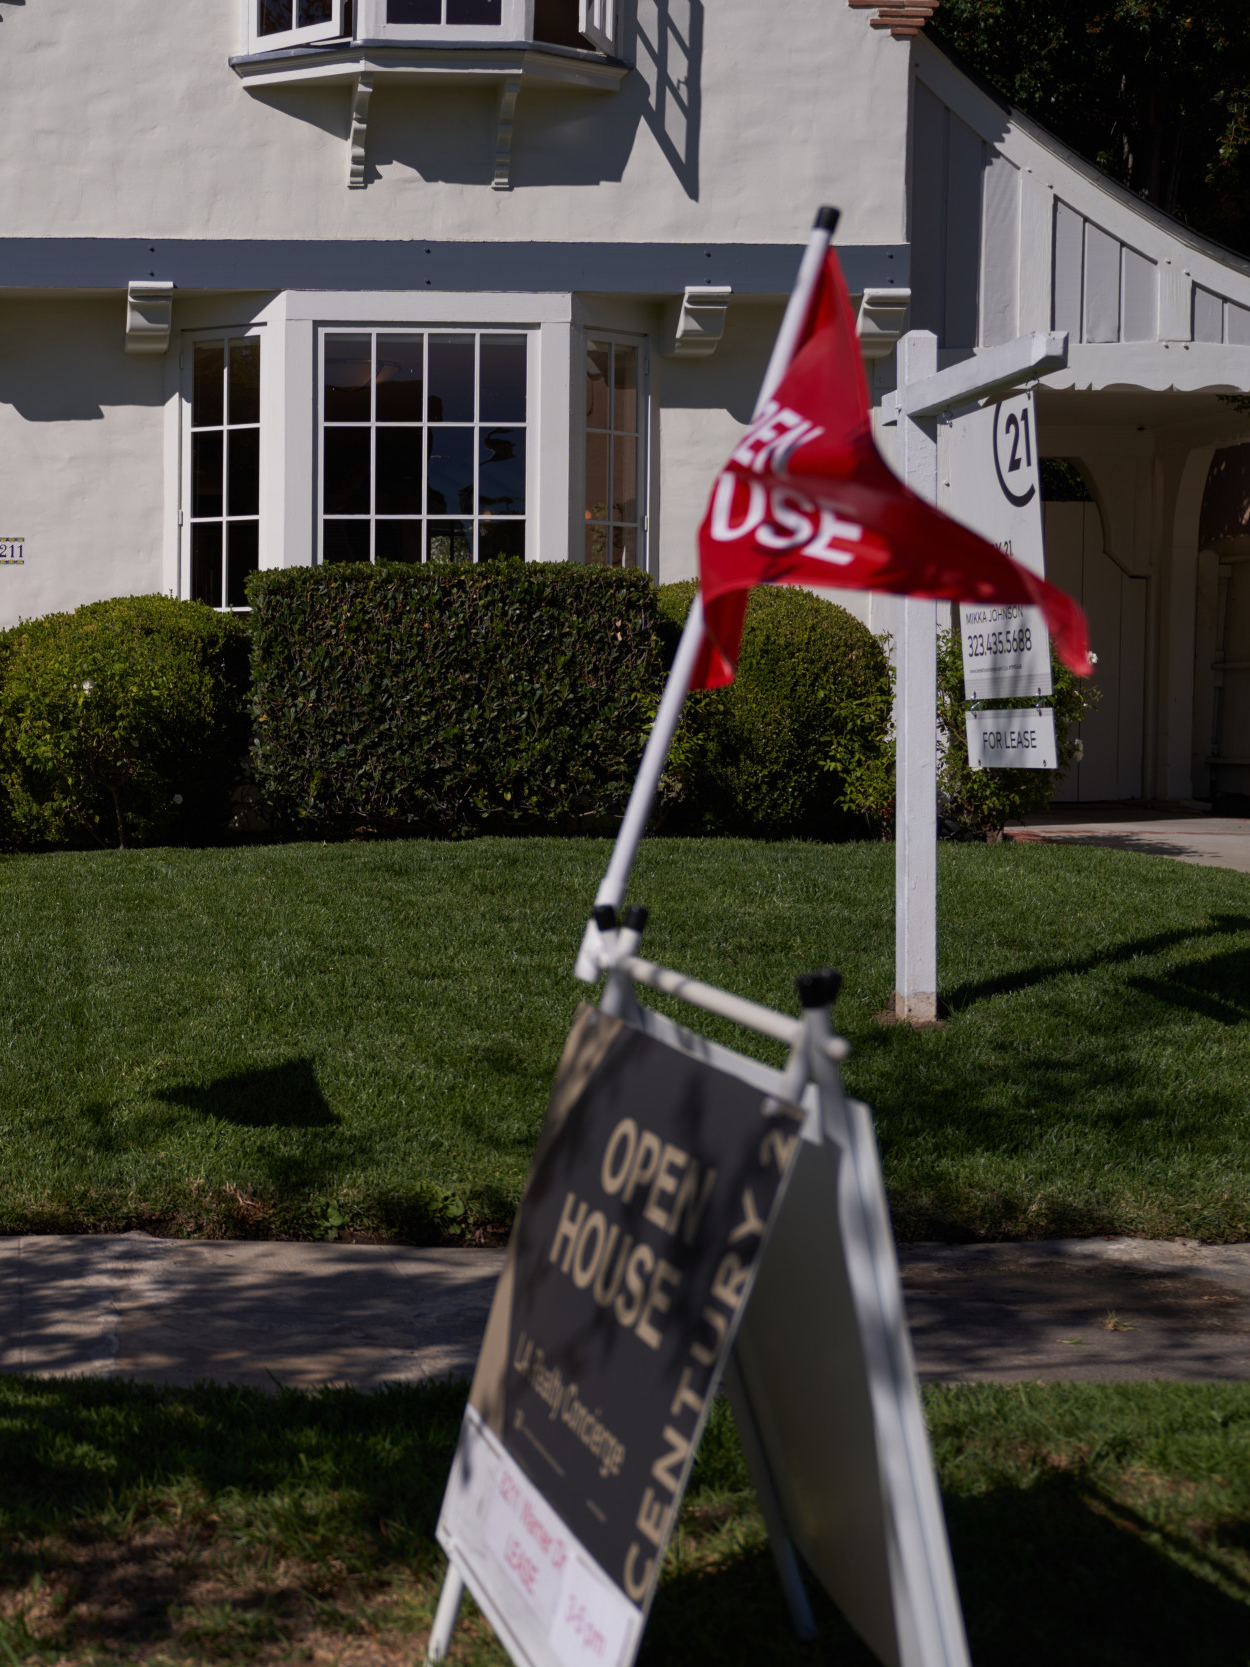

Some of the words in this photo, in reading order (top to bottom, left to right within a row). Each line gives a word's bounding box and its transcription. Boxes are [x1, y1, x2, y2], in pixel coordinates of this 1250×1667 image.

[1005, 407, 1032, 473] 21
[711, 470, 863, 565] USE
[965, 610, 987, 625] MIKKA
[989, 605, 1023, 622] JOHNSON
[967, 627, 1032, 657] 323.435.5688
[982, 731, 1002, 749] FOR
[1004, 730, 1037, 749] LEASE
[602, 1117, 717, 1244] OPEN
[549, 1191, 682, 1351] HOUSE
[561, 1382, 626, 1478] Concierge
[623, 1187, 767, 1602] CENTURY
